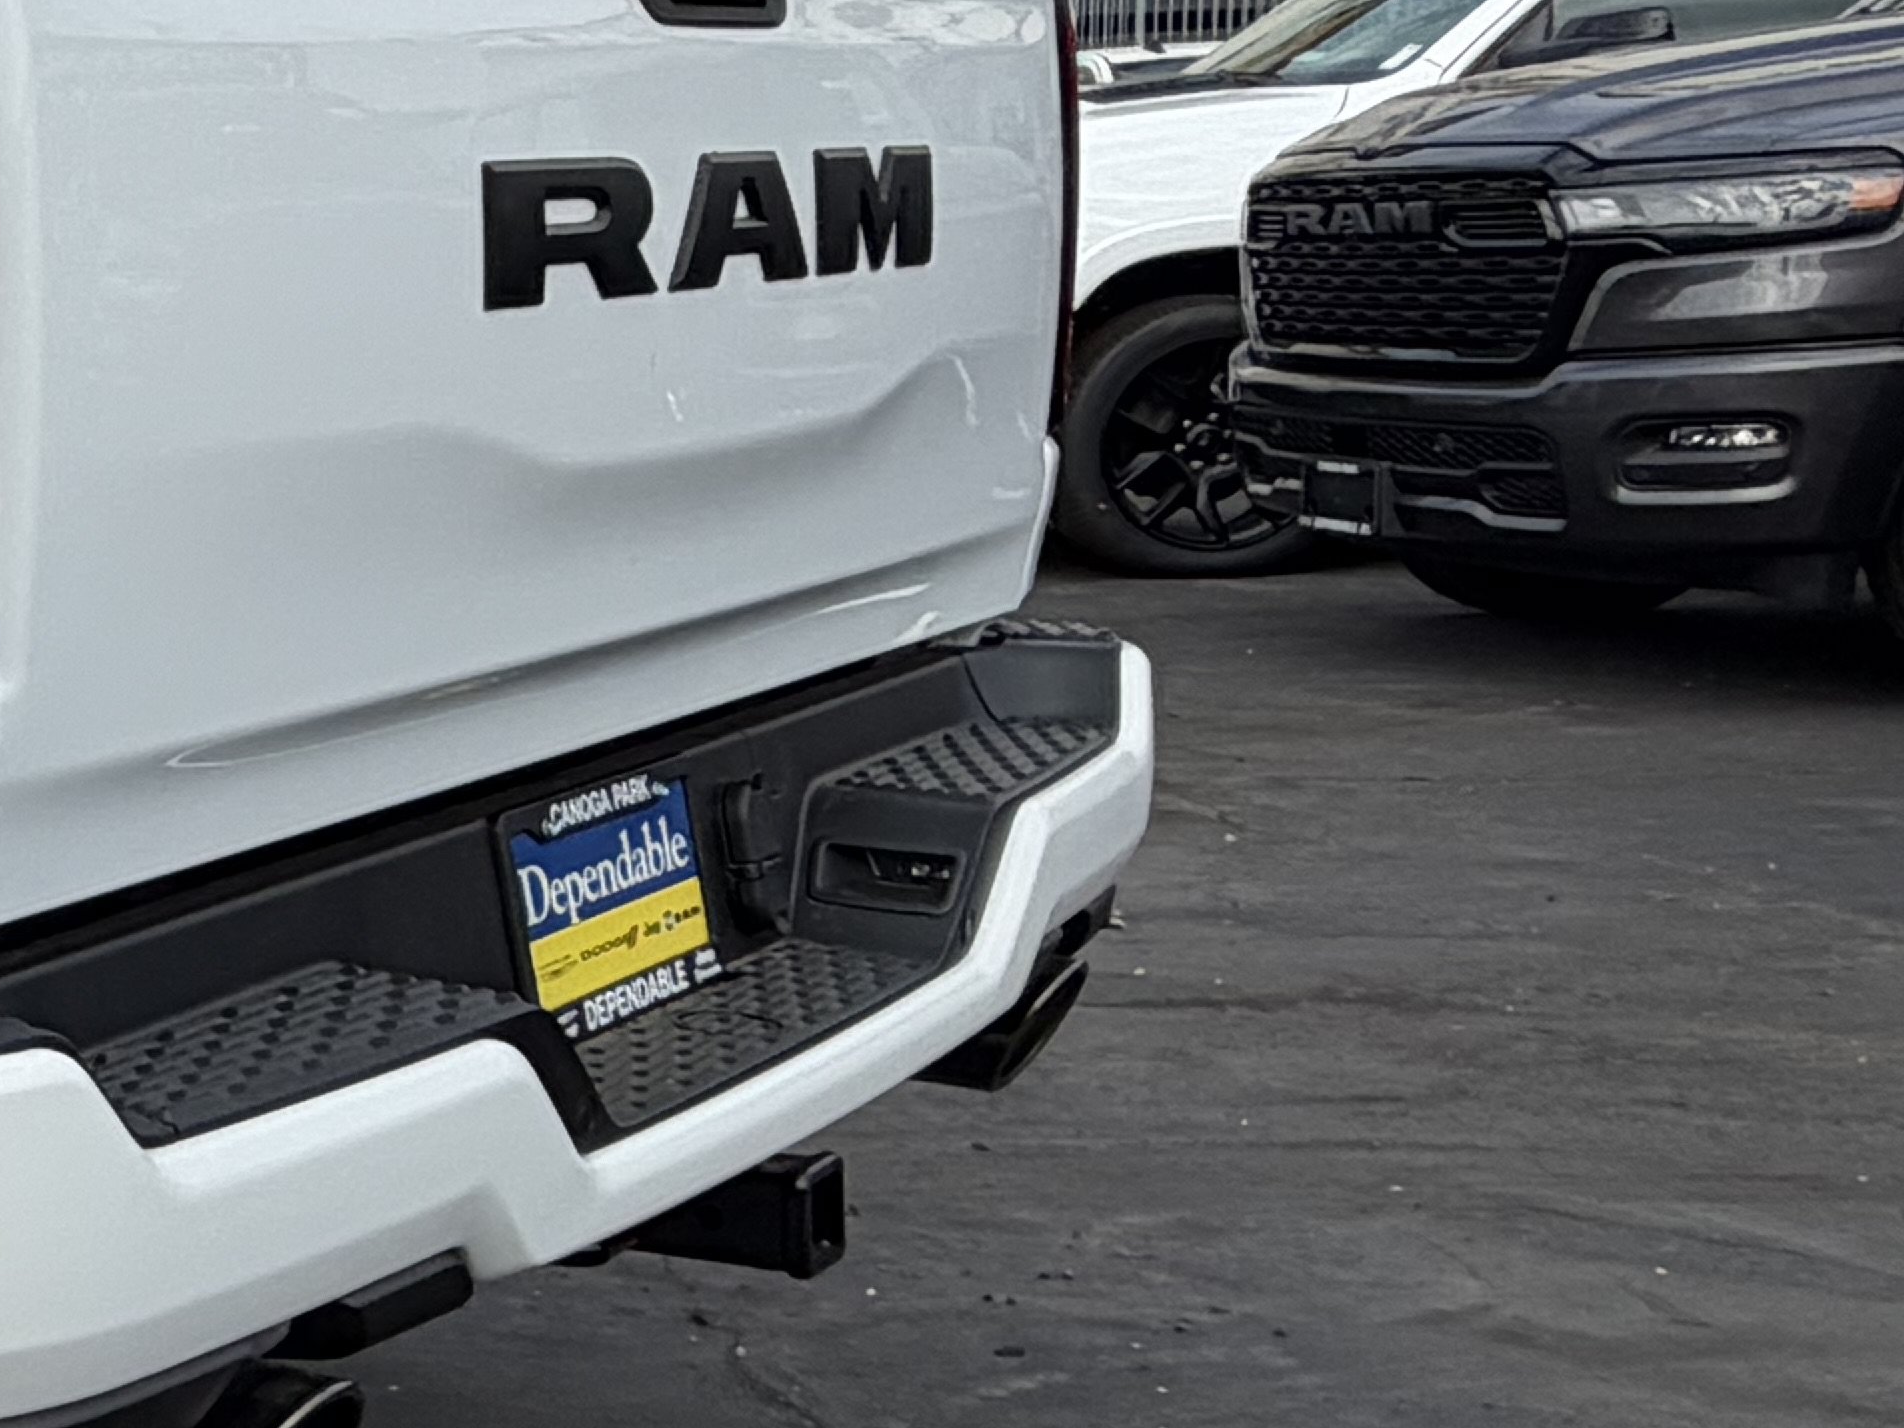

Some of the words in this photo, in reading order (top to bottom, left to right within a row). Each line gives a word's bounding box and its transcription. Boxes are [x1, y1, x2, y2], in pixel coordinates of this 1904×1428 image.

[481, 144, 933, 312] RAM
[1286, 200, 1433, 235] RAM
[549, 788, 613, 836] CANOGA
[611, 774, 652, 811] PARK
[517, 814, 690, 928] Dependable
[582, 959, 691, 1032] DEPENDABLE
